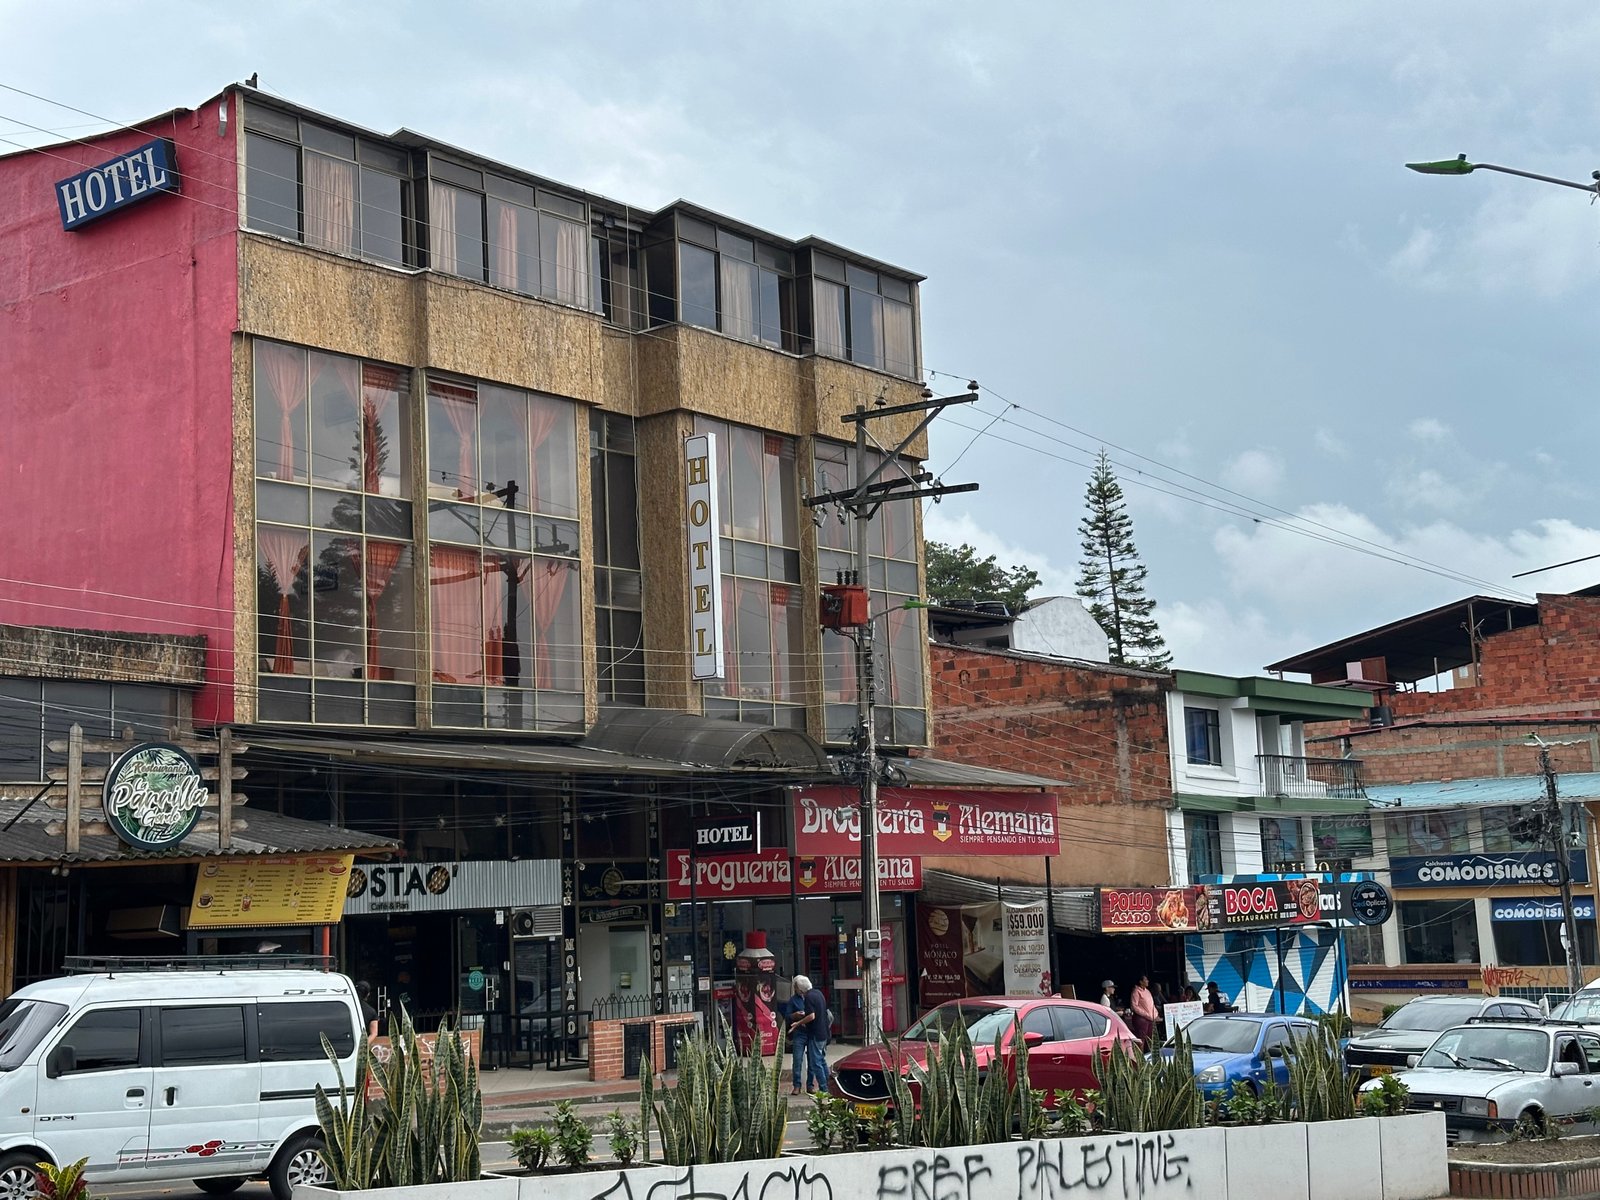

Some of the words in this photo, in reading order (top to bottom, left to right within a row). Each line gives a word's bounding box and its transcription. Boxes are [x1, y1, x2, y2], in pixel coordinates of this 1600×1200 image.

[60, 147, 166, 223] HOTEL
[687, 456, 712, 656] HOTEL
[131, 761, 189, 774] Restaurante
[111, 775, 209, 816] Parrilla
[800, 799, 924, 841] Drogería
[958, 803, 1055, 836] Alemana
[697, 825, 753, 845] HOTEL
[960, 836, 984, 844] SIEMPRE
[986, 836, 1017, 844] PENSANDO
[823, 855, 914, 880] Aleana
[1418, 863, 1553, 882] COMODISIMOS
[1109, 892, 1153, 912] POLLO
[1225, 887, 1278, 915] BOCA
[1010, 913, 1044, 929] $59.000
[1112, 912, 1152, 924] ASADO
[1227, 913, 1278, 923] RESTAURANTE
[1494, 906, 1592, 918] COMODISIOS
[924, 949, 957, 959] MÓNACO
[935, 959, 948, 967] SPA
[565, 938, 576, 1035] MONACO
[118, 1153, 178, 1162] SPORT
